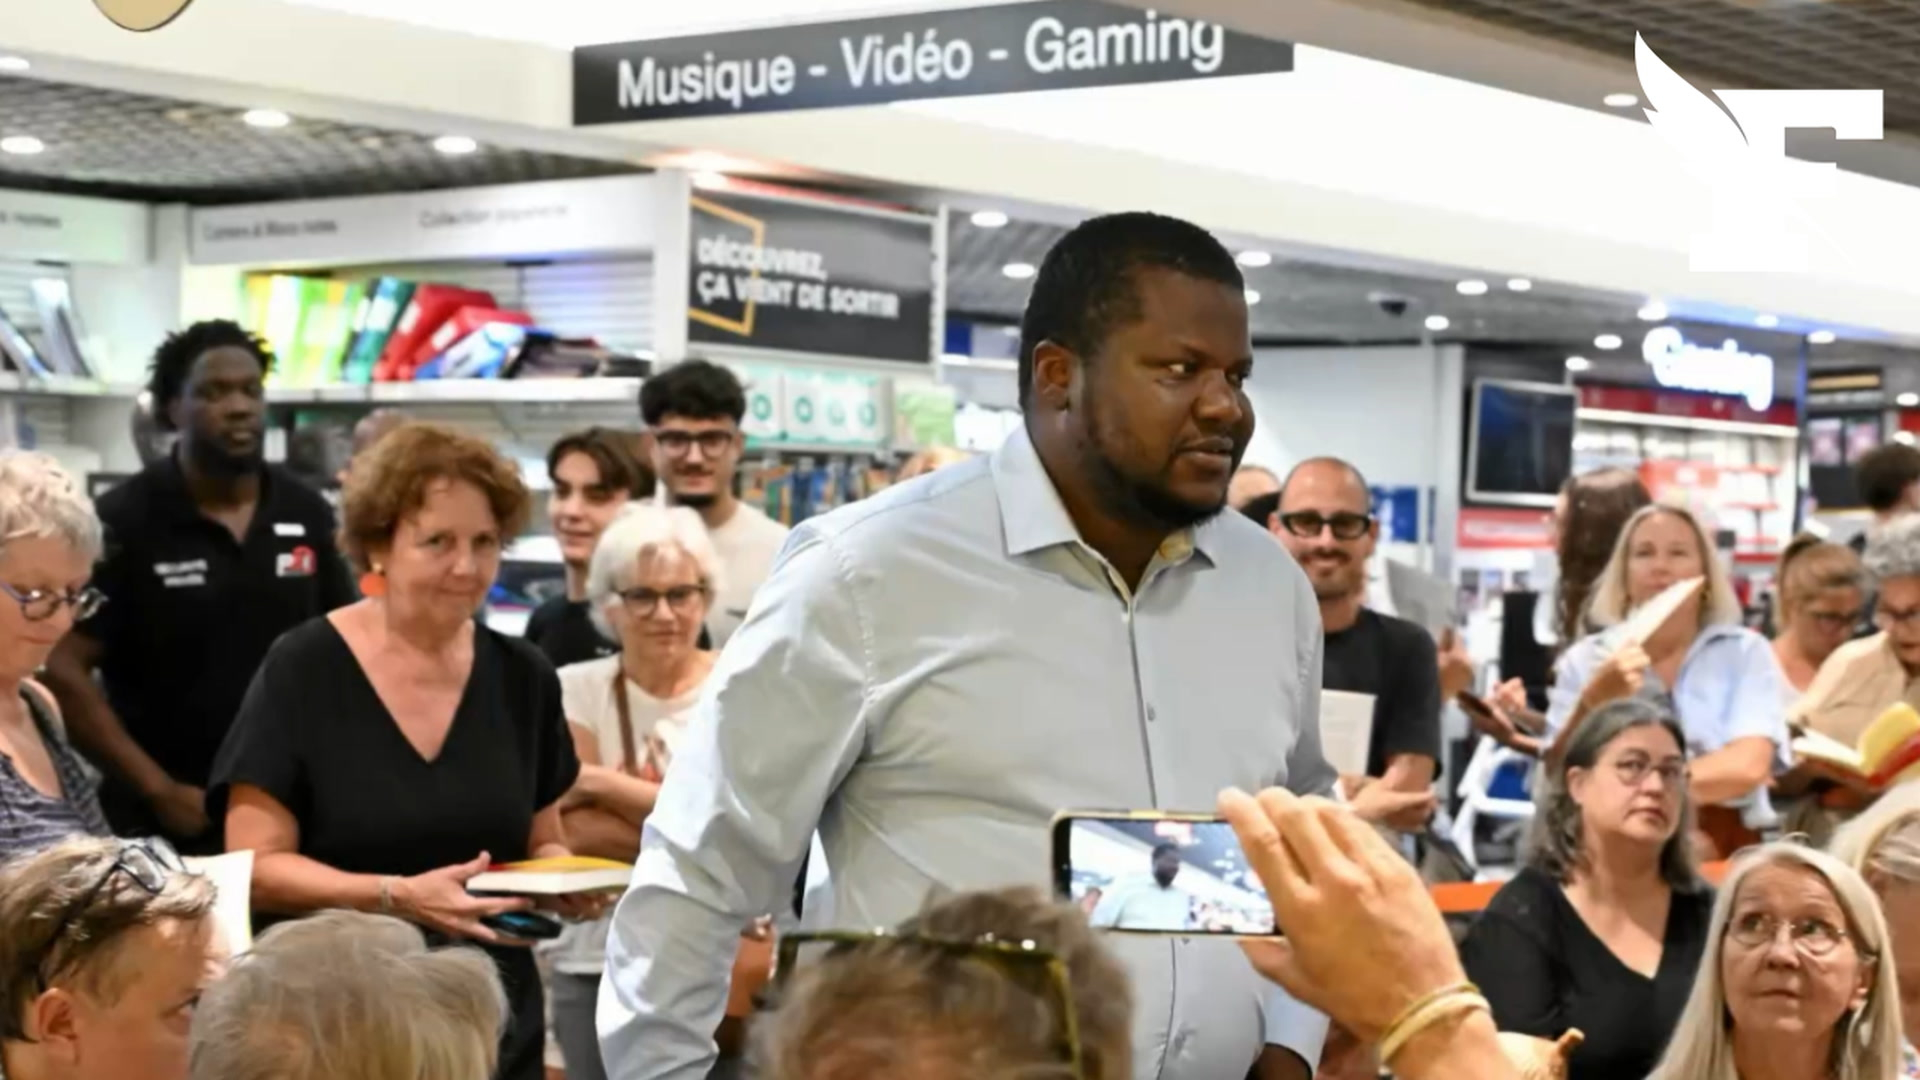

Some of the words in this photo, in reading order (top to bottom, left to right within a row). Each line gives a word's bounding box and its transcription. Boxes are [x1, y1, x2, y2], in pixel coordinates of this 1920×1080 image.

[617, 50, 796, 109] Musique
[807, 64, 828, 76] -
[839, 28, 974, 88] Vidéo
[988, 49, 1009, 60] -
[1025, 9, 1224, 73] Gaming
[697, 270, 731, 305] ÇA
[734, 275, 795, 307] VIENT
[796, 283, 826, 311] DE
[829, 286, 901, 320] SORTIR
